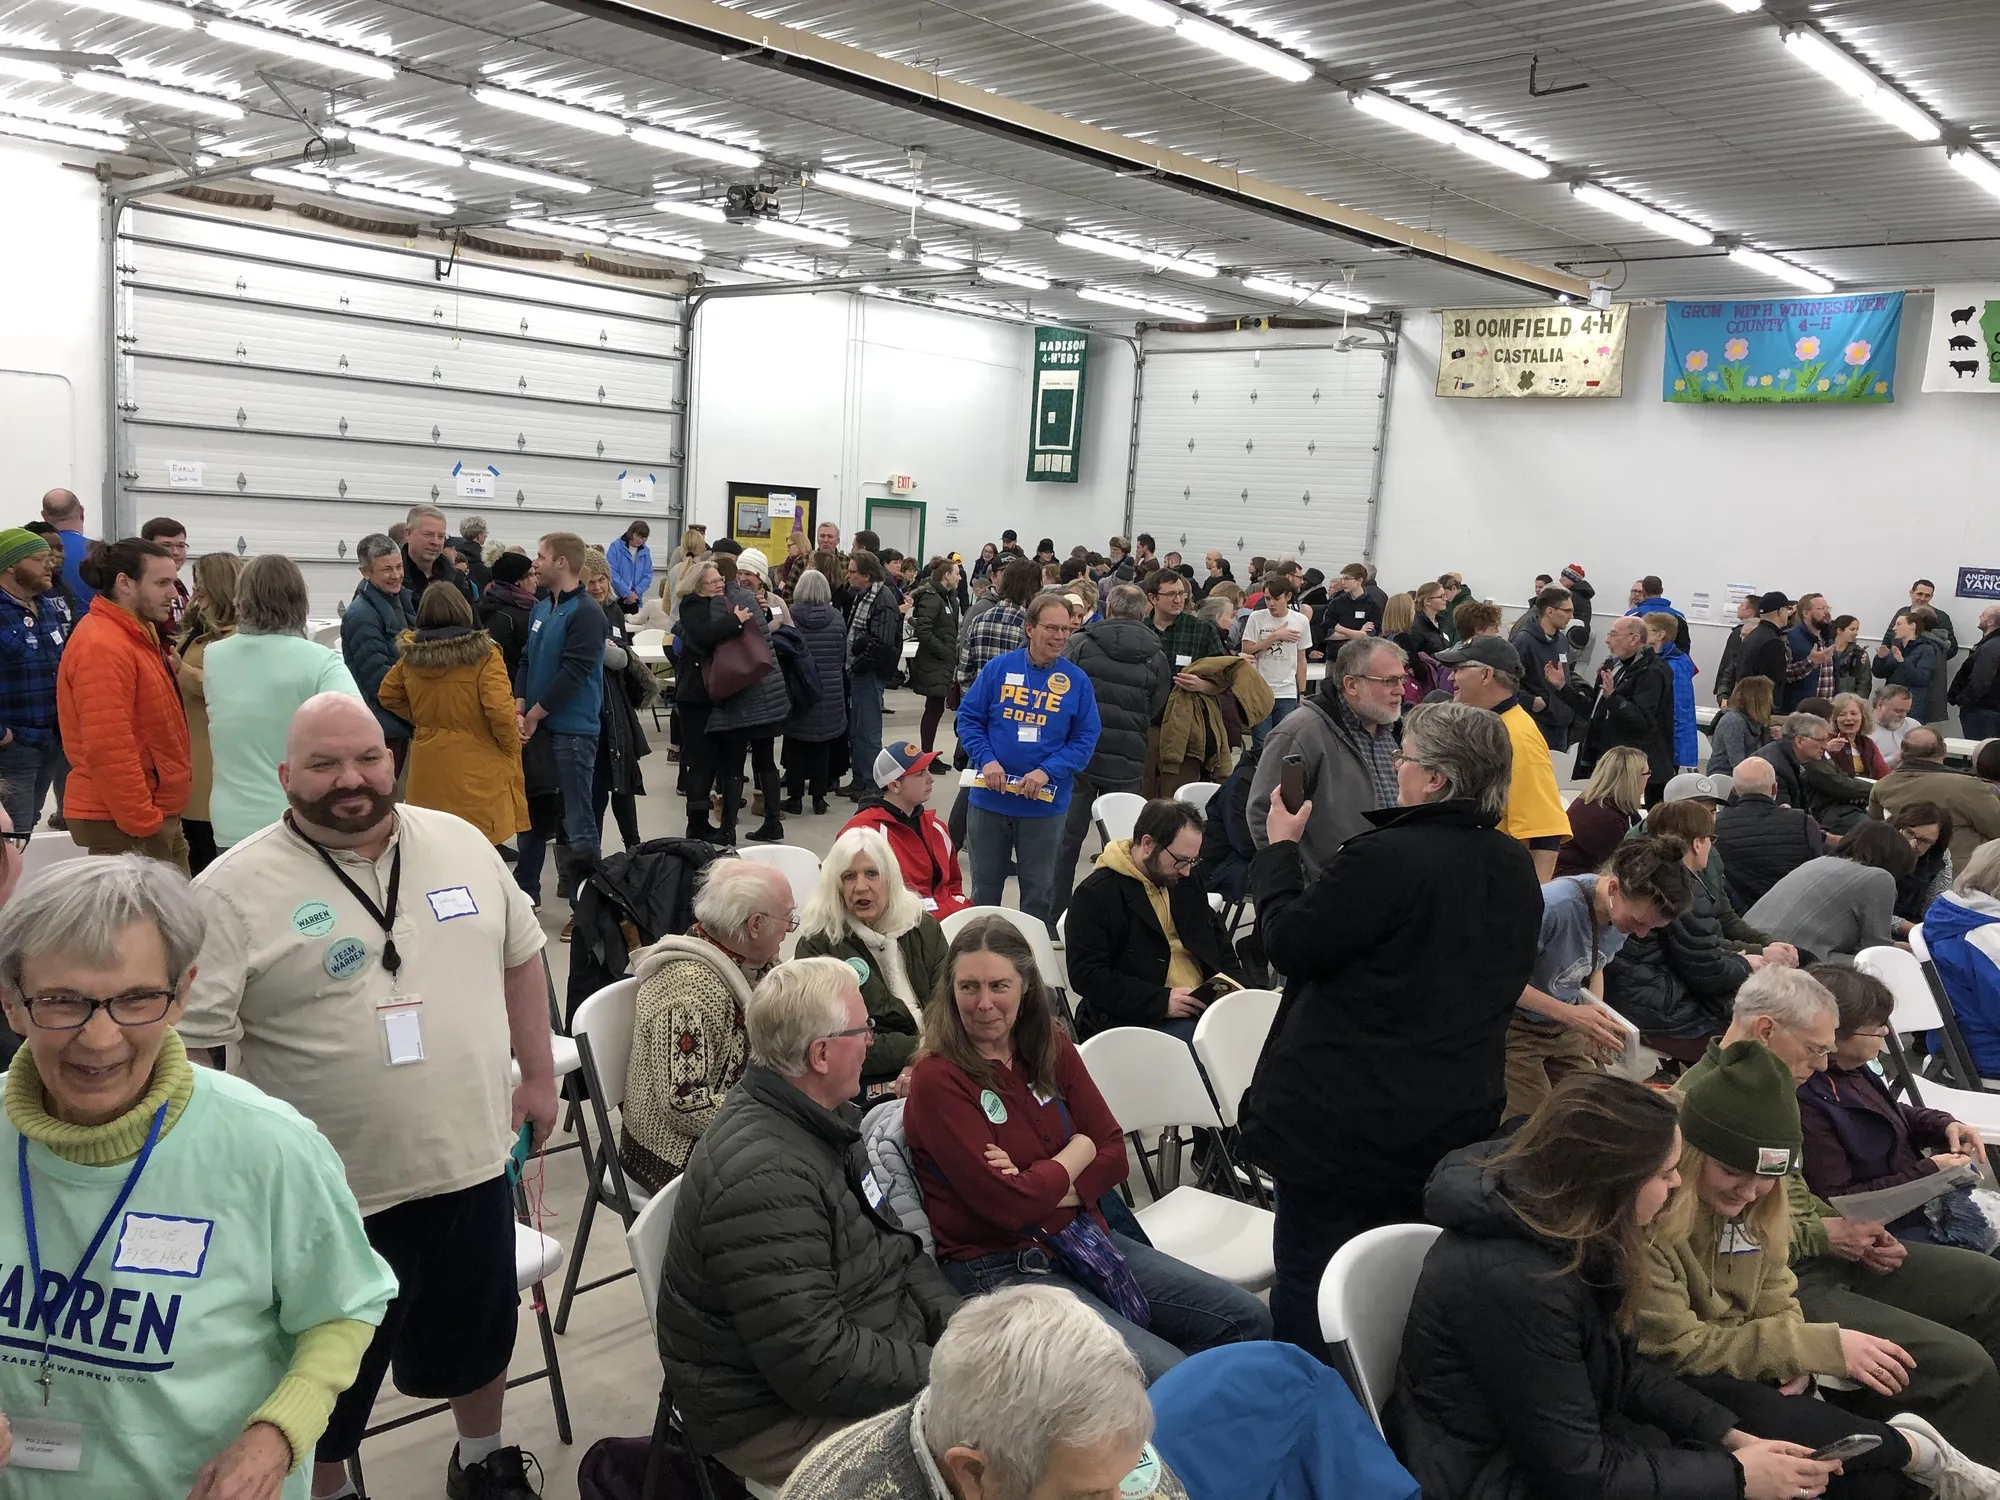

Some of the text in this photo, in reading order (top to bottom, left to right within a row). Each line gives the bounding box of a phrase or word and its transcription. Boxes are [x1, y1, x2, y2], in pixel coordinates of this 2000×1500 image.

[1681, 297, 1887, 319] GROW WITH WINNESHIEK
[1581, 313, 1613, 334] 4-H
[1726, 316, 1832, 334] COUNTY 4-H
[1039, 340, 1086, 352] MADISON
[1494, 347, 1563, 364] CASTALIA
[897, 475, 911, 489] EXIT
[1000, 685, 1063, 713] PETE
[1003, 707, 1047, 726] 2020
[296, 909, 330, 928] WARREN
[331, 948, 366, 974] WARREN
[333, 944, 357, 963] TEAM
[121, 1248, 188, 1267] FISCHER
[0, 1264, 182, 1356] ARREN
[0, 1354, 148, 1385] ZABETHWARREN.COM
[1121, 1487, 1143, 1498] RUARY
